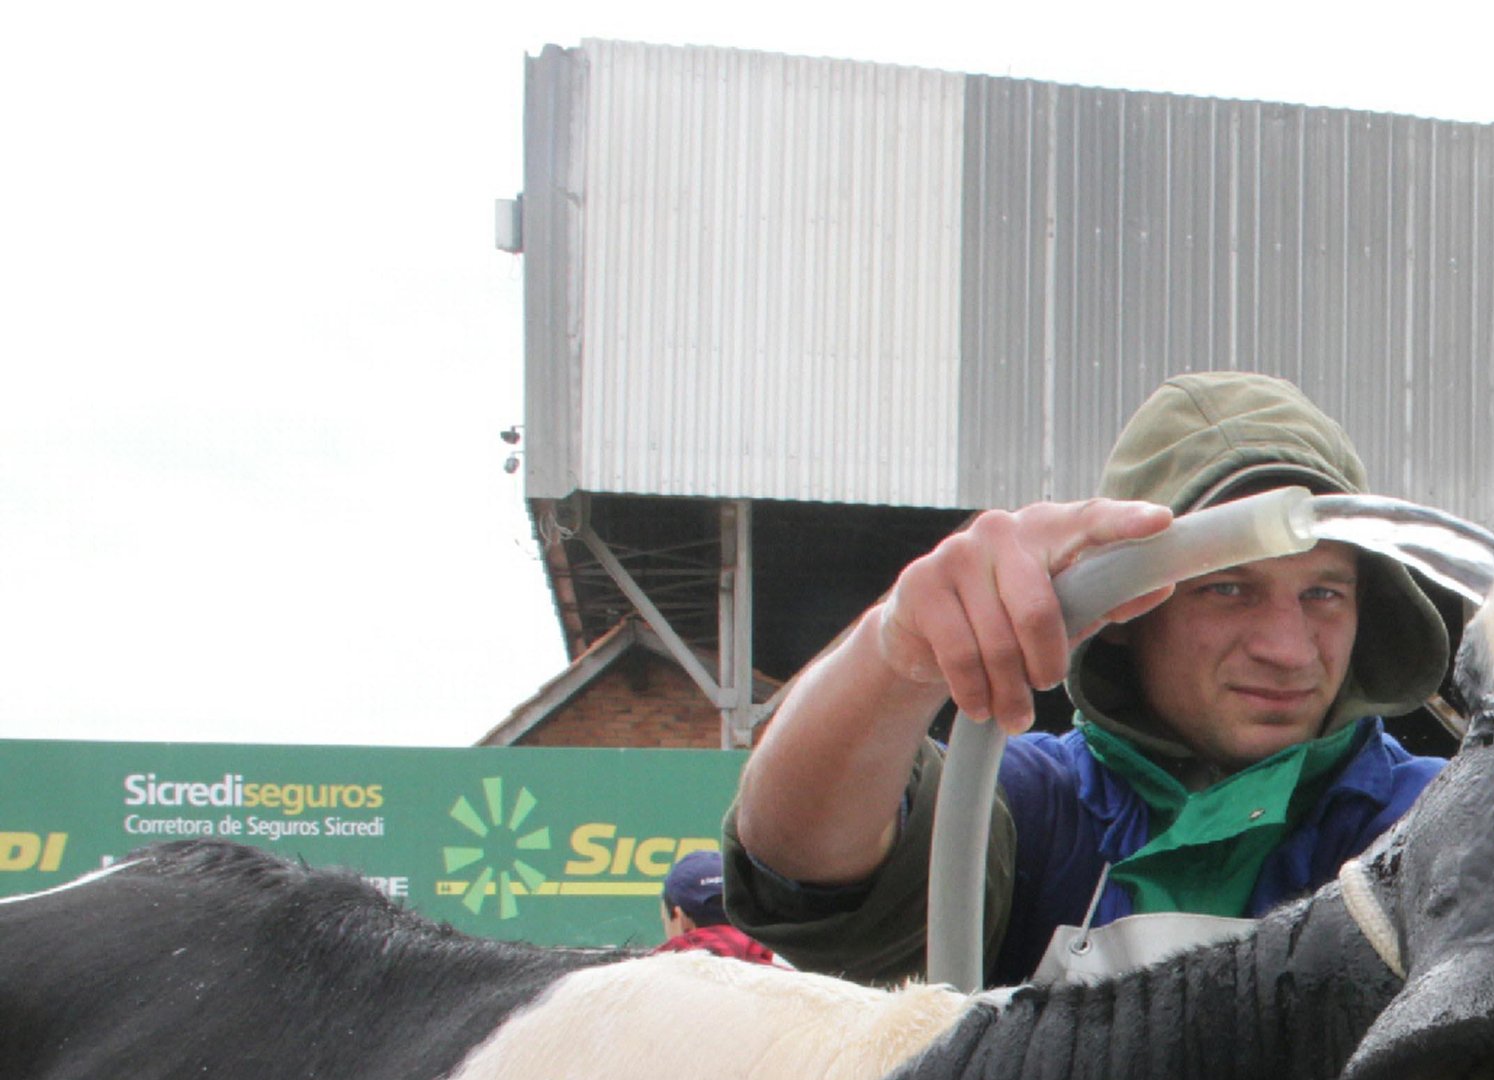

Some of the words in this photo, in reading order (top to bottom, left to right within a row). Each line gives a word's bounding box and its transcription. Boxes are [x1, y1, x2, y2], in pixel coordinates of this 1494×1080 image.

[123, 774, 384, 816] Sicrediseguros
[124, 814, 213, 836] Corretora
[218, 816, 242, 836] de
[248, 816, 320, 840] Seguros
[325, 817, 385, 836] Sicredi
